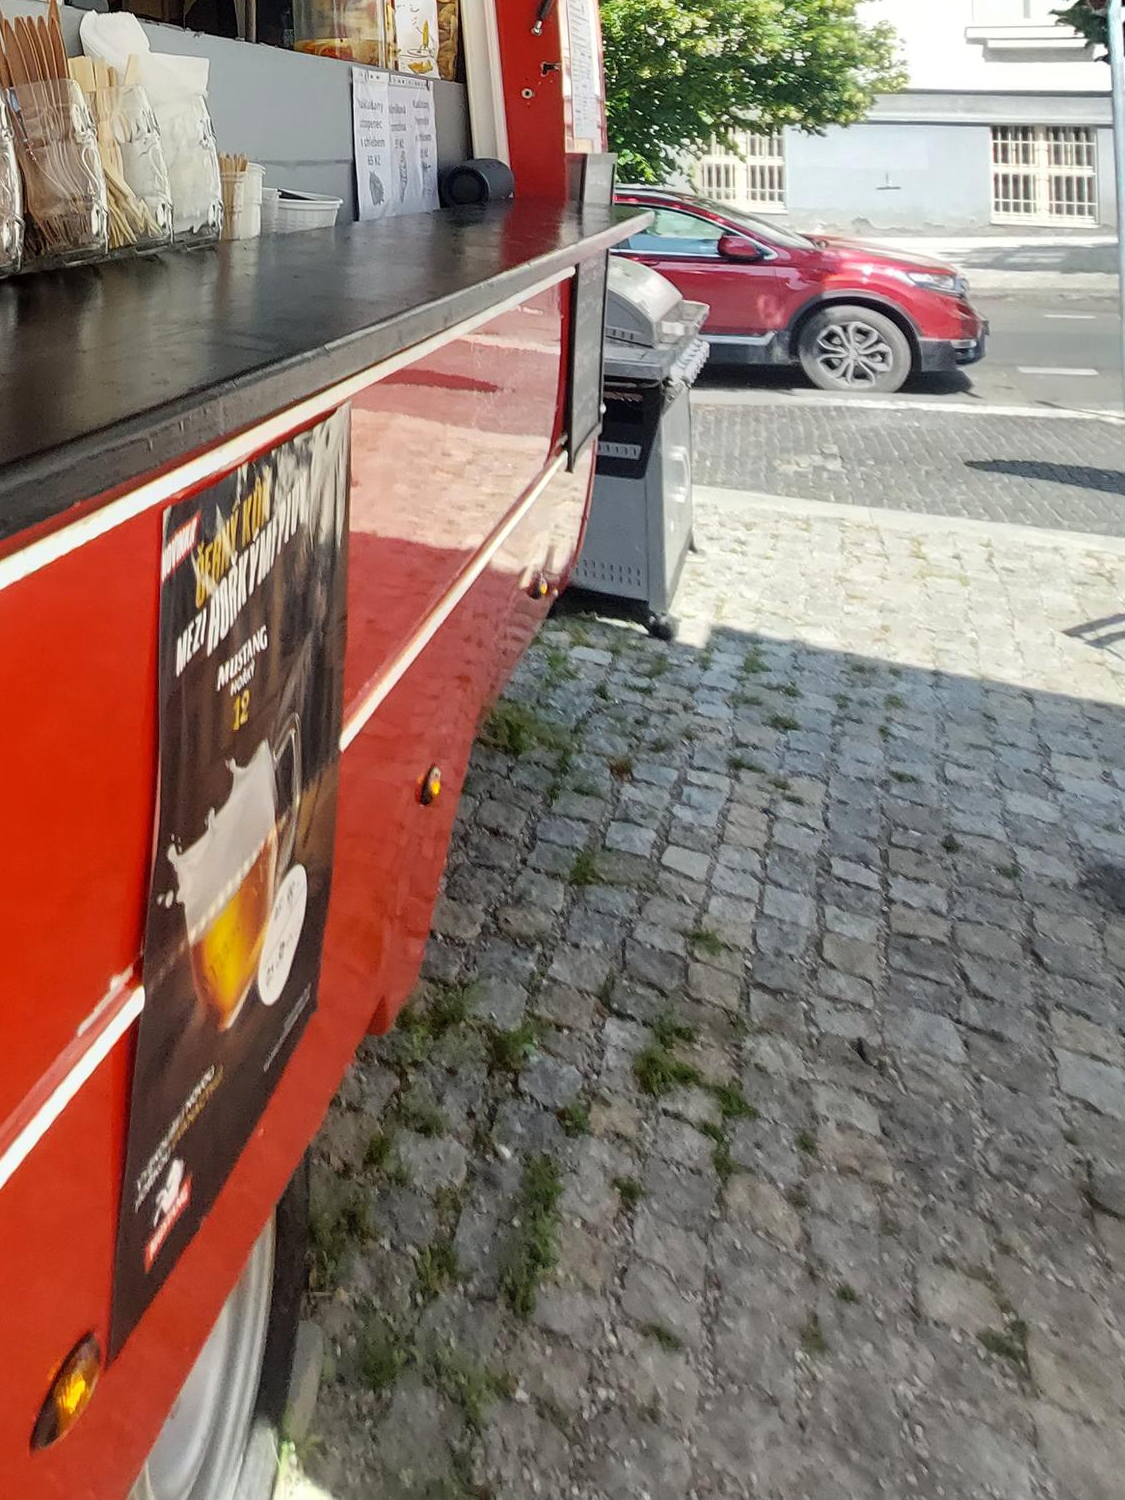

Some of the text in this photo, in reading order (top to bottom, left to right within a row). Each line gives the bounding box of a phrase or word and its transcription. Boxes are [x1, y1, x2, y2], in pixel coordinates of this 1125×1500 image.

[176, 607, 207, 678] MEZI
[217, 624, 269, 691] MUSTANG
[233, 690, 251, 732] 12
